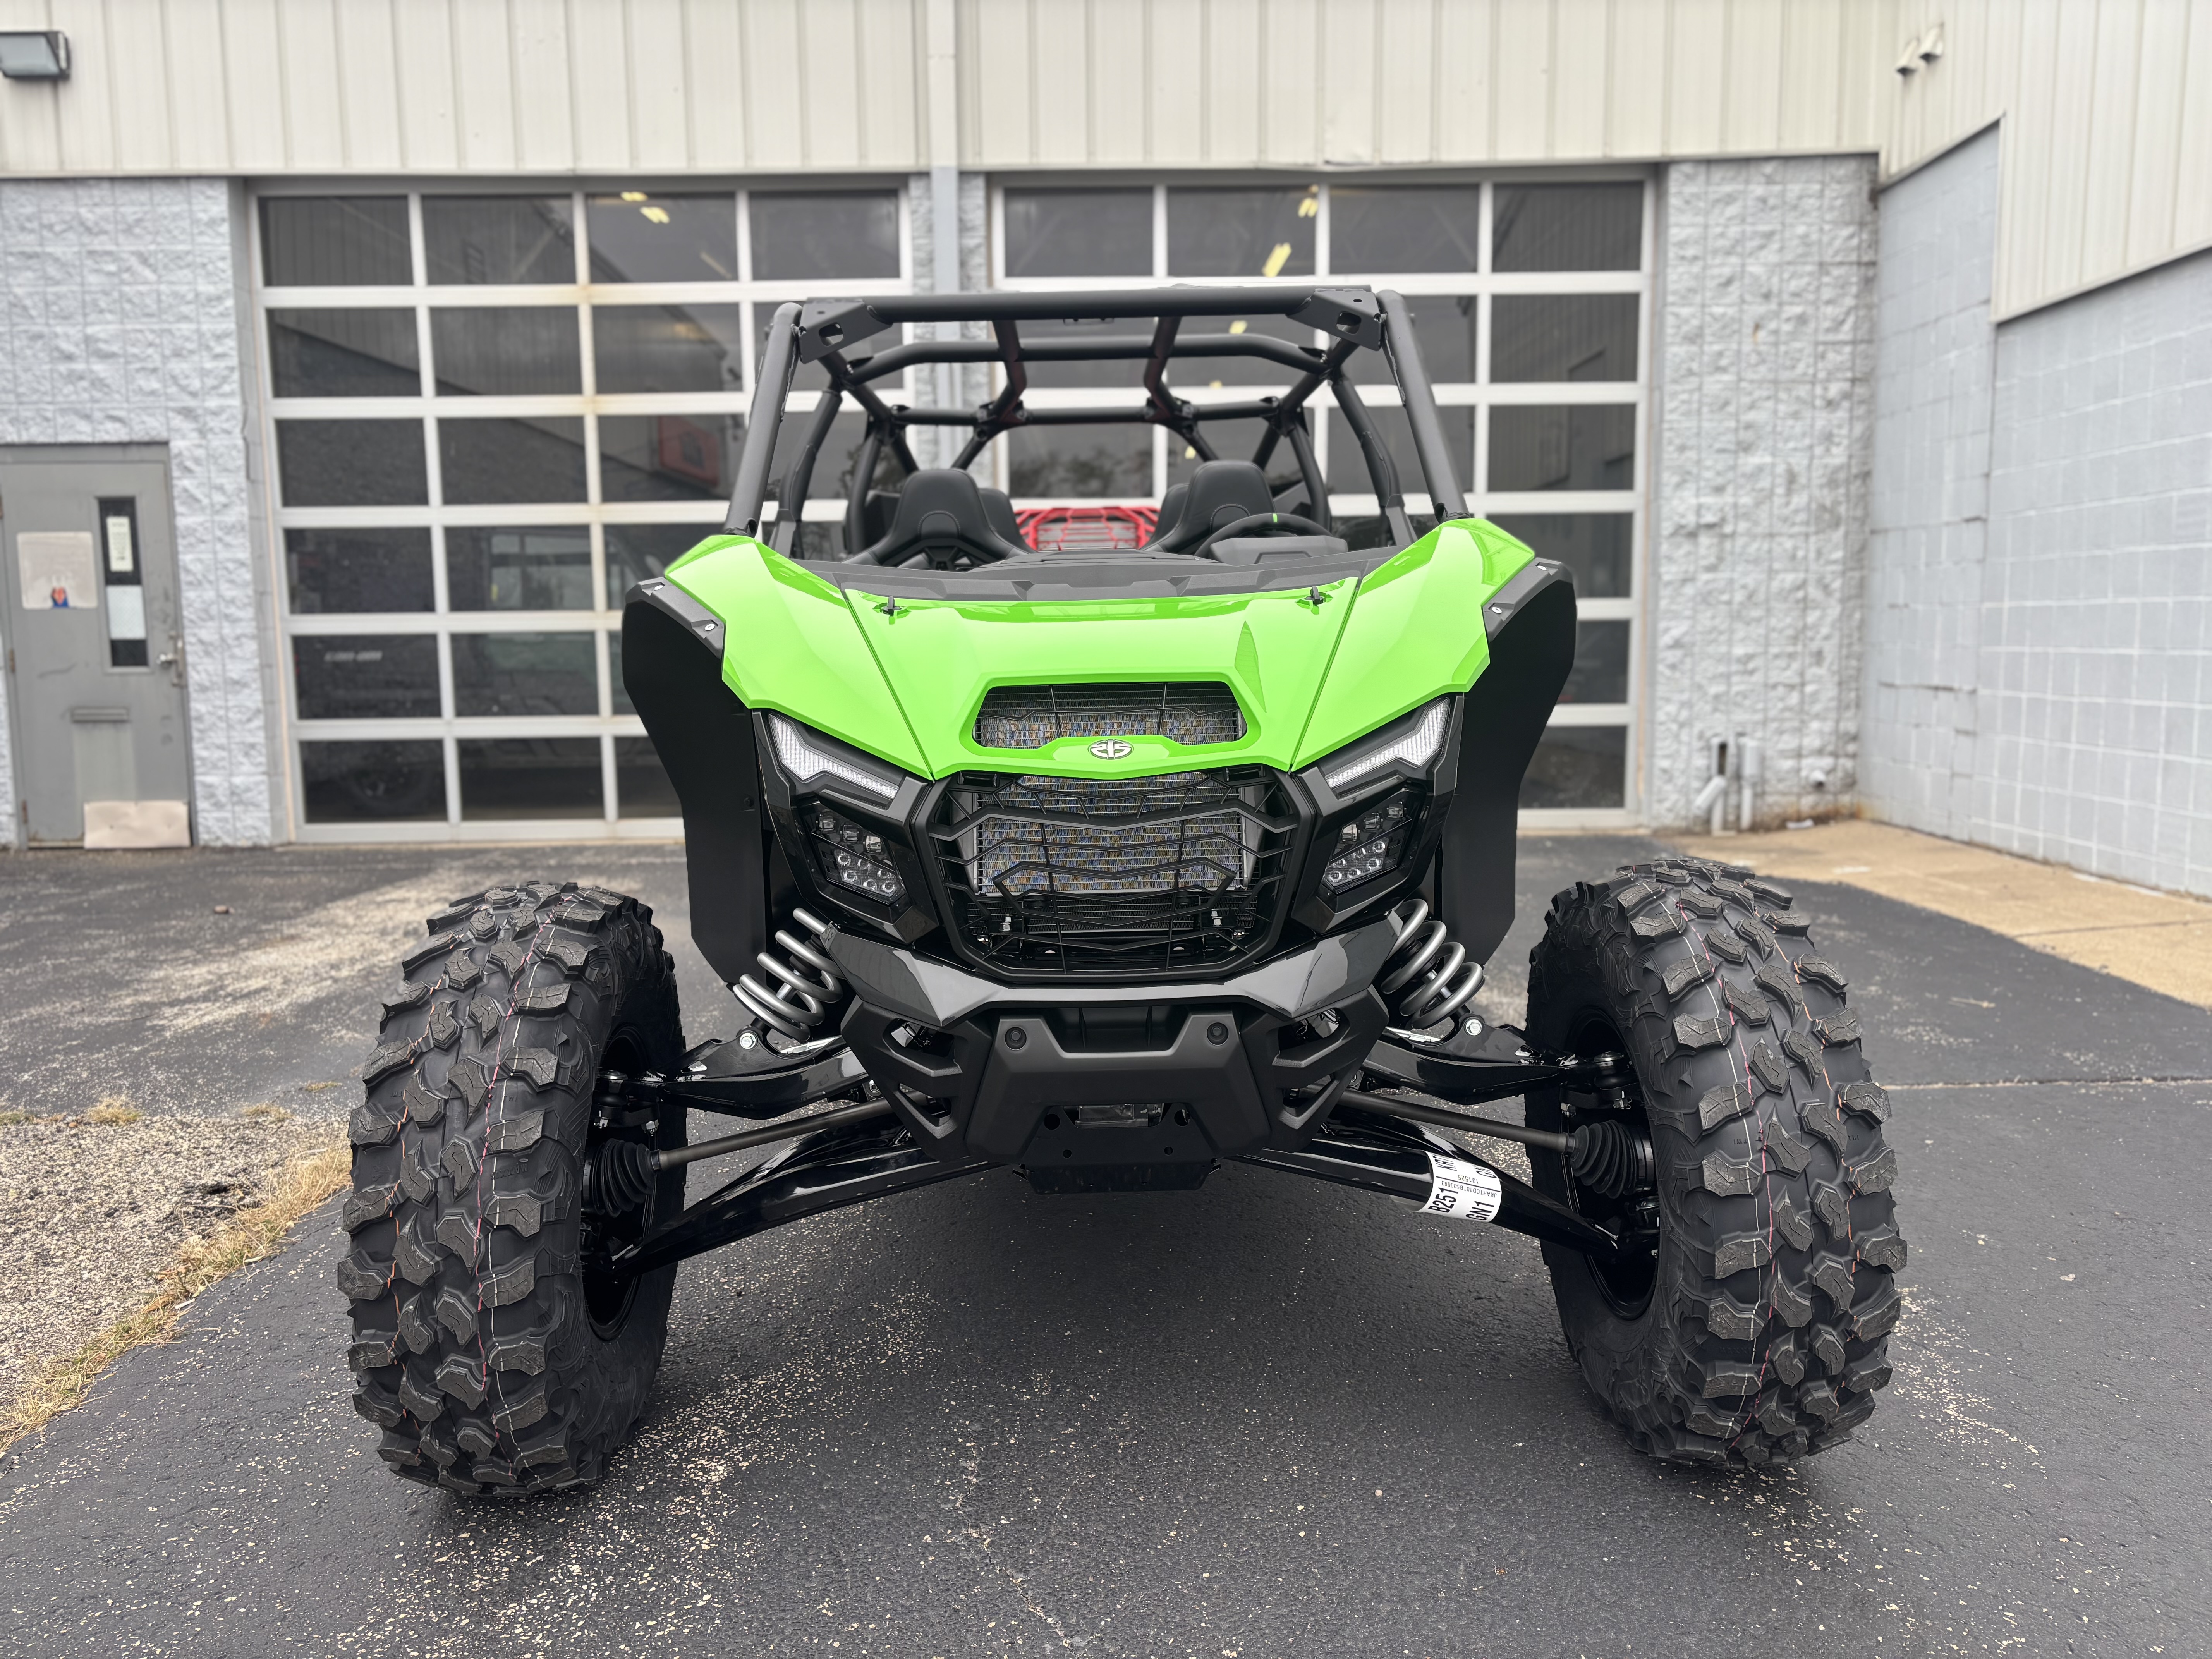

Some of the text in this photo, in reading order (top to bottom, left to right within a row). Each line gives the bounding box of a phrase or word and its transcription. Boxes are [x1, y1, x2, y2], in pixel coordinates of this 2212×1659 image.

[1457, 1174, 1479, 1184] 101525
[1441, 1180, 1498, 1198] JKARTCD10TB500083
[1428, 1187, 1458, 1213] B251
[1465, 1200, 1494, 1221] GN1
